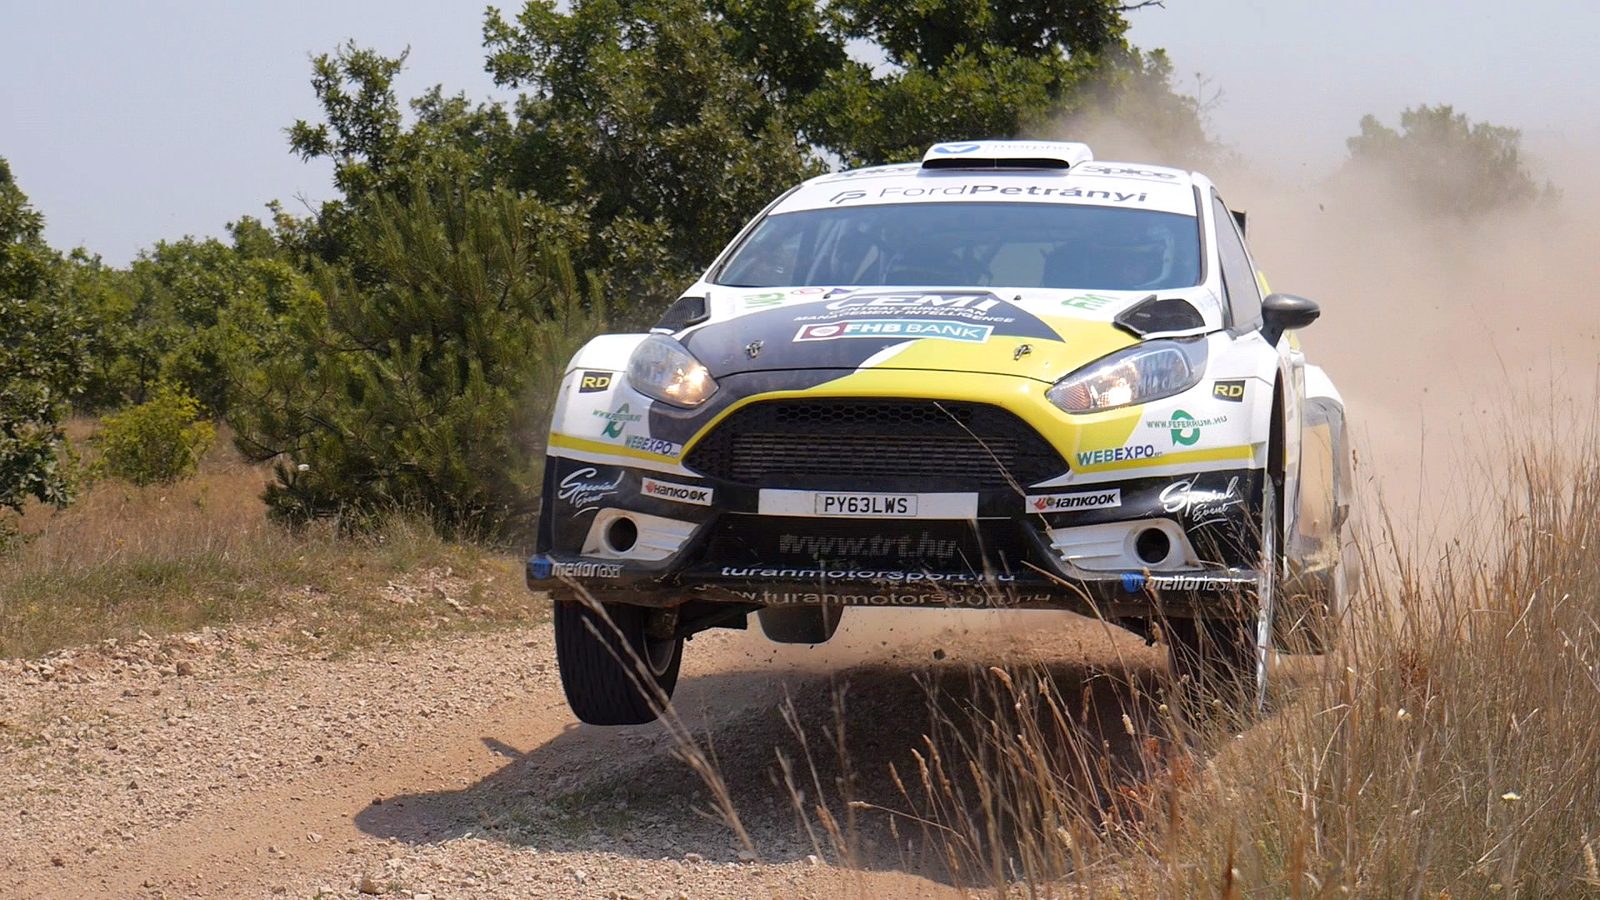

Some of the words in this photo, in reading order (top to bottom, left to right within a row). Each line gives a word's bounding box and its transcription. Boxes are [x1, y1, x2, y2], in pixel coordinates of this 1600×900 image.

[879, 184, 1148, 202] FordPetrányi
[826, 294, 1000, 312] CEMI
[901, 306, 988, 316] EUROPEAN
[904, 310, 1016, 323] INTELLIGENCE
[842, 323, 902, 333] FHB
[905, 323, 982, 338] BANK
[581, 376, 610, 388] RD
[1213, 384, 1243, 397] RD
[1077, 444, 1155, 466] WEBEXPO
[824, 496, 908, 514] PY63LWS
[779, 530, 957, 559] www.trt.hu
